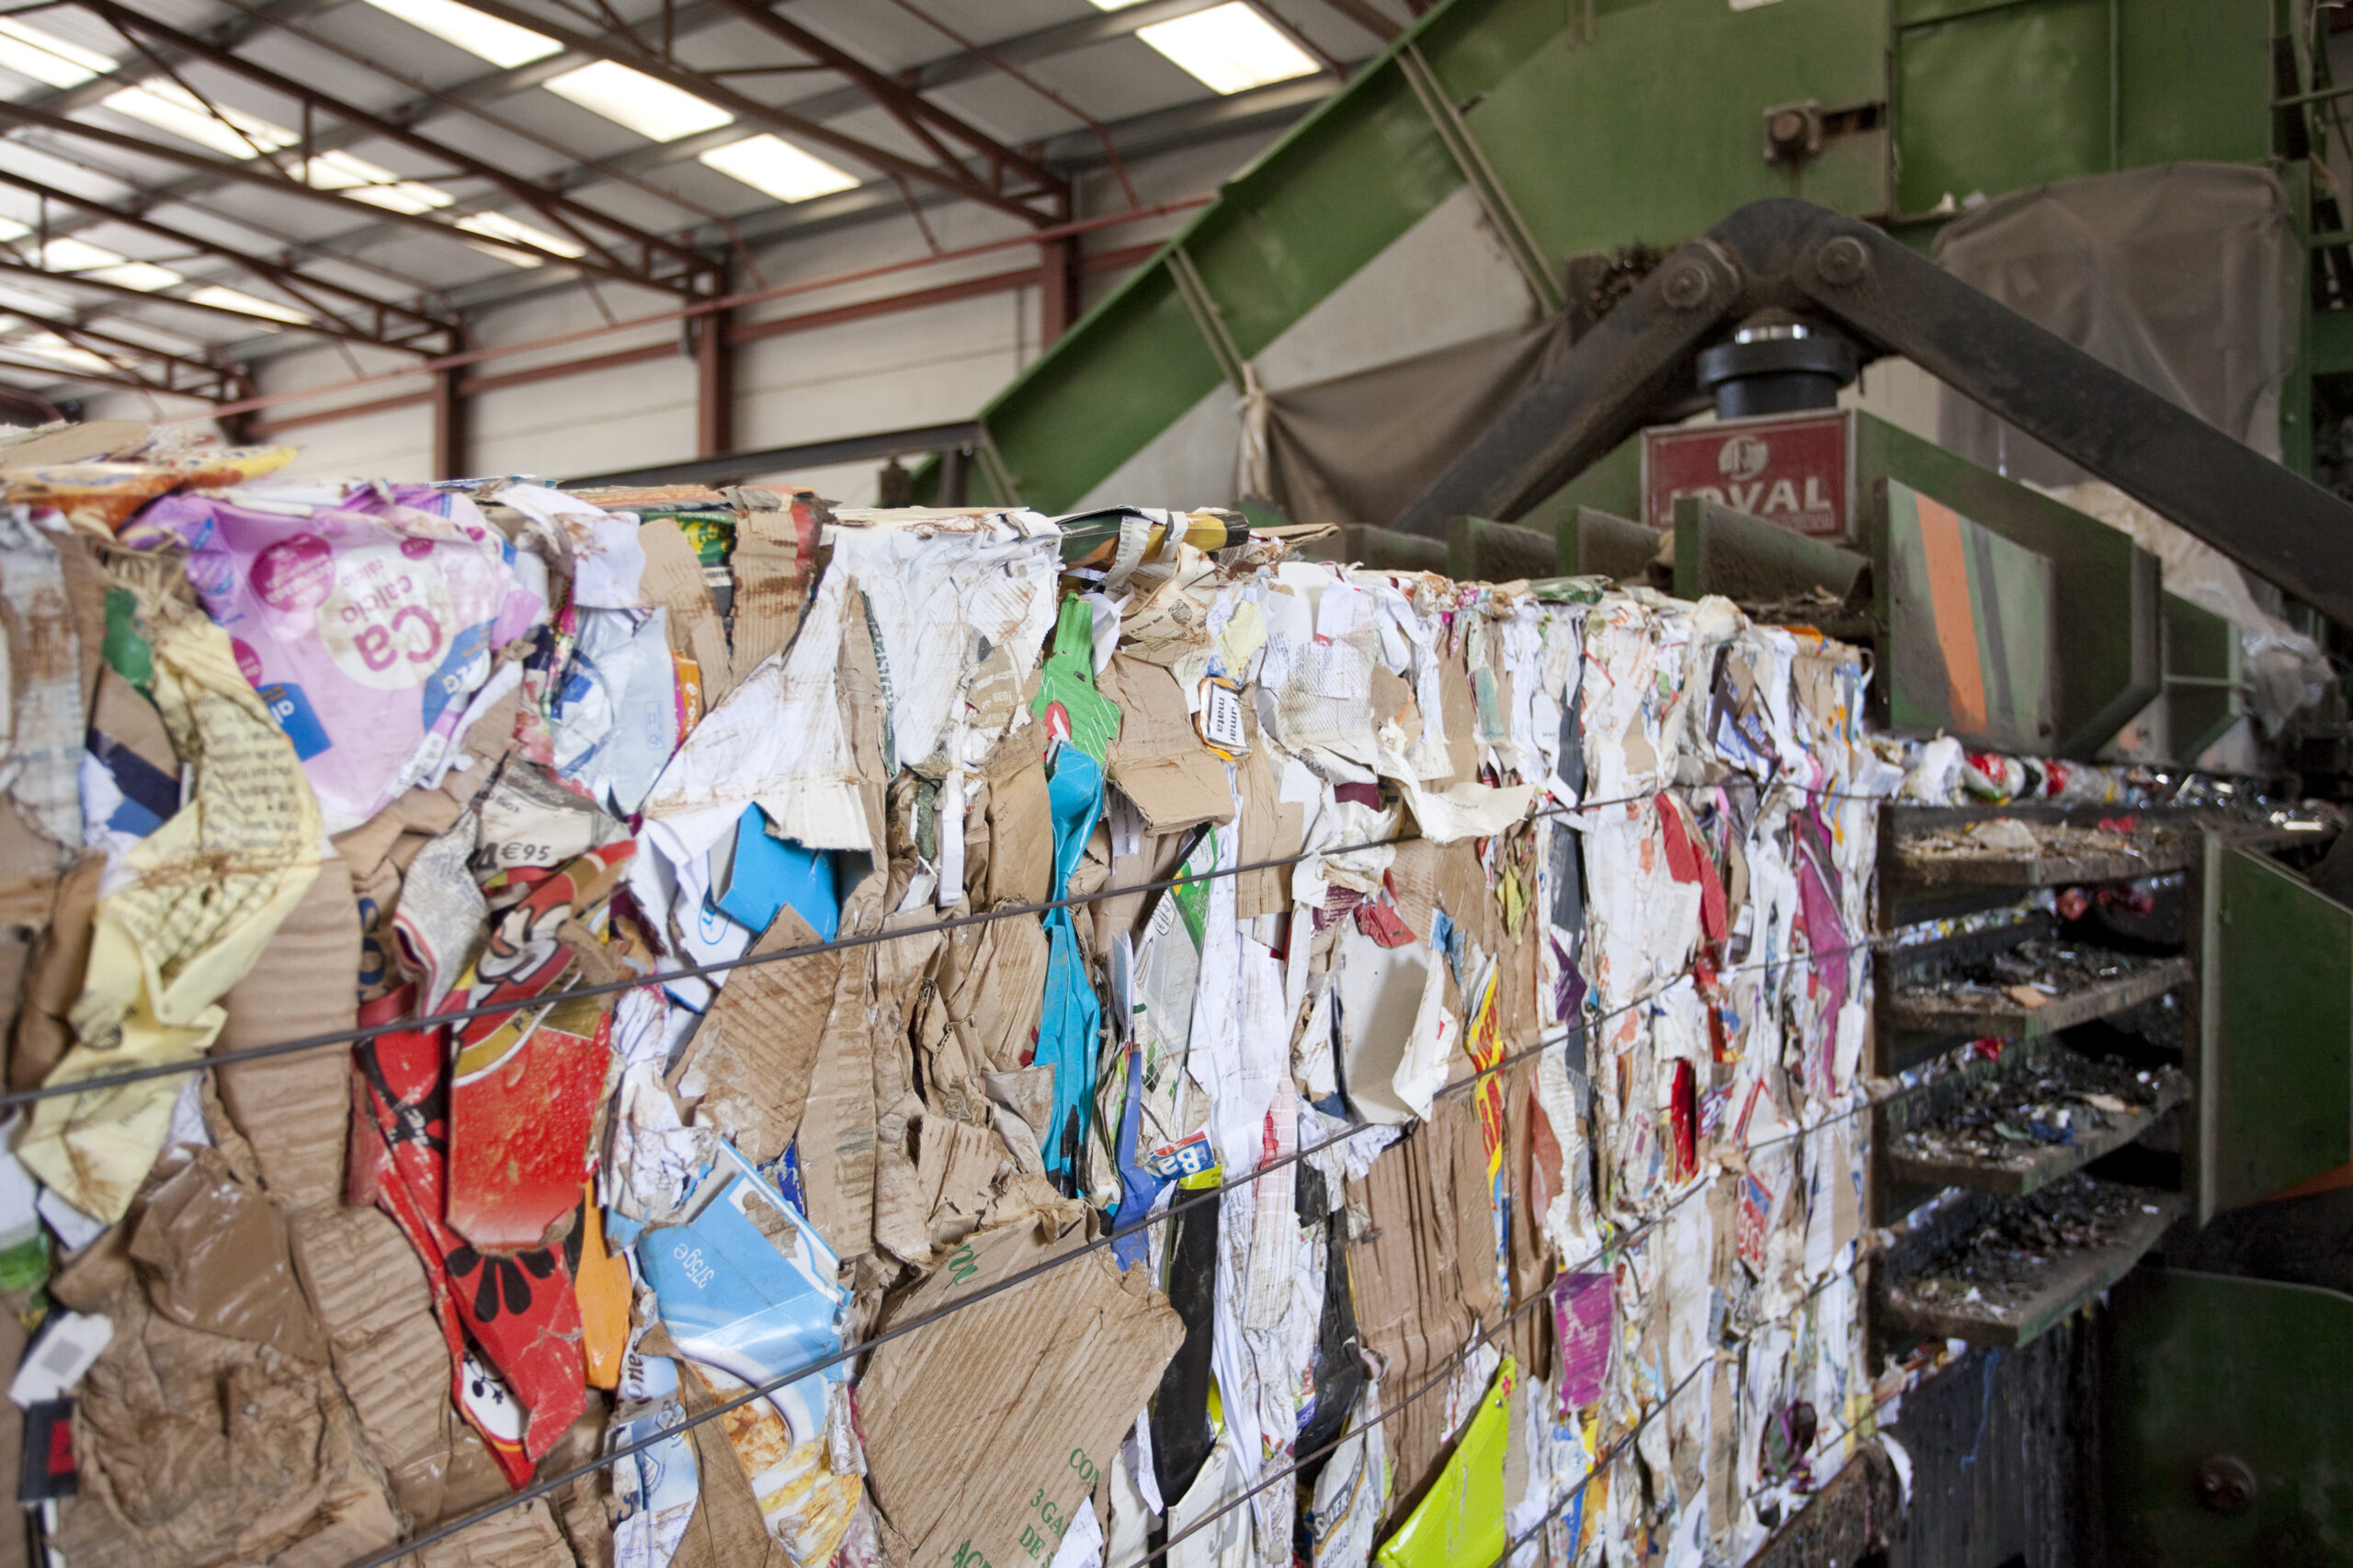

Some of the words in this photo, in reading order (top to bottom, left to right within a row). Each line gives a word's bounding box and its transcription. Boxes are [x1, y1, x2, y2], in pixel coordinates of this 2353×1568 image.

[340, 575, 413, 625] calcio
[353, 605, 441, 672] Ca
[1216, 696, 1227, 733] mata
[1228, 696, 1241, 744] Fumar
[1030, 1488, 1045, 1508] 3
[1019, 1524, 1046, 1556] DE
